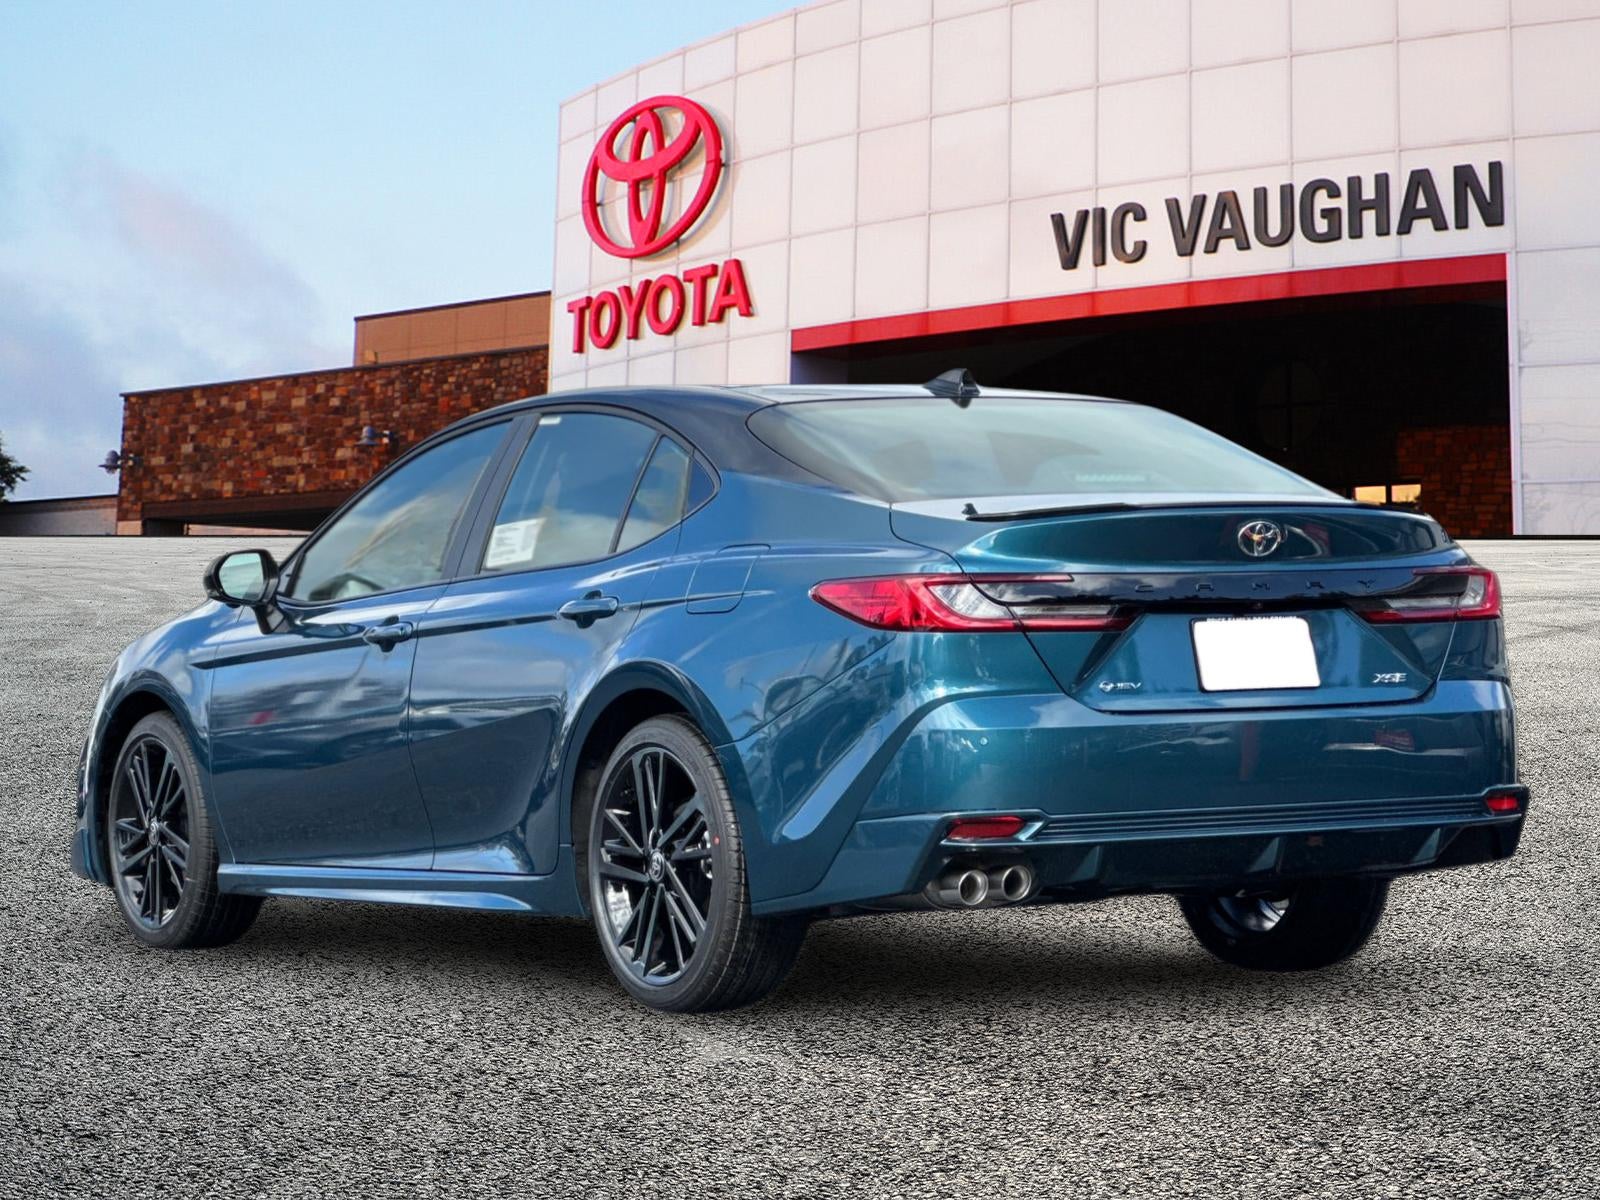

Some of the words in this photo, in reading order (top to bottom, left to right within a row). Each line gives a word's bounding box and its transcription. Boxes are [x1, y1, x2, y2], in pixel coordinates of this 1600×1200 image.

[1051, 202, 1147, 271] VIC
[1165, 160, 1505, 257] VAUGHAN
[567, 258, 754, 353] TOYOTA
[1134, 579, 1376, 593] CAMRY
[1372, 672, 1407, 683] XSE
